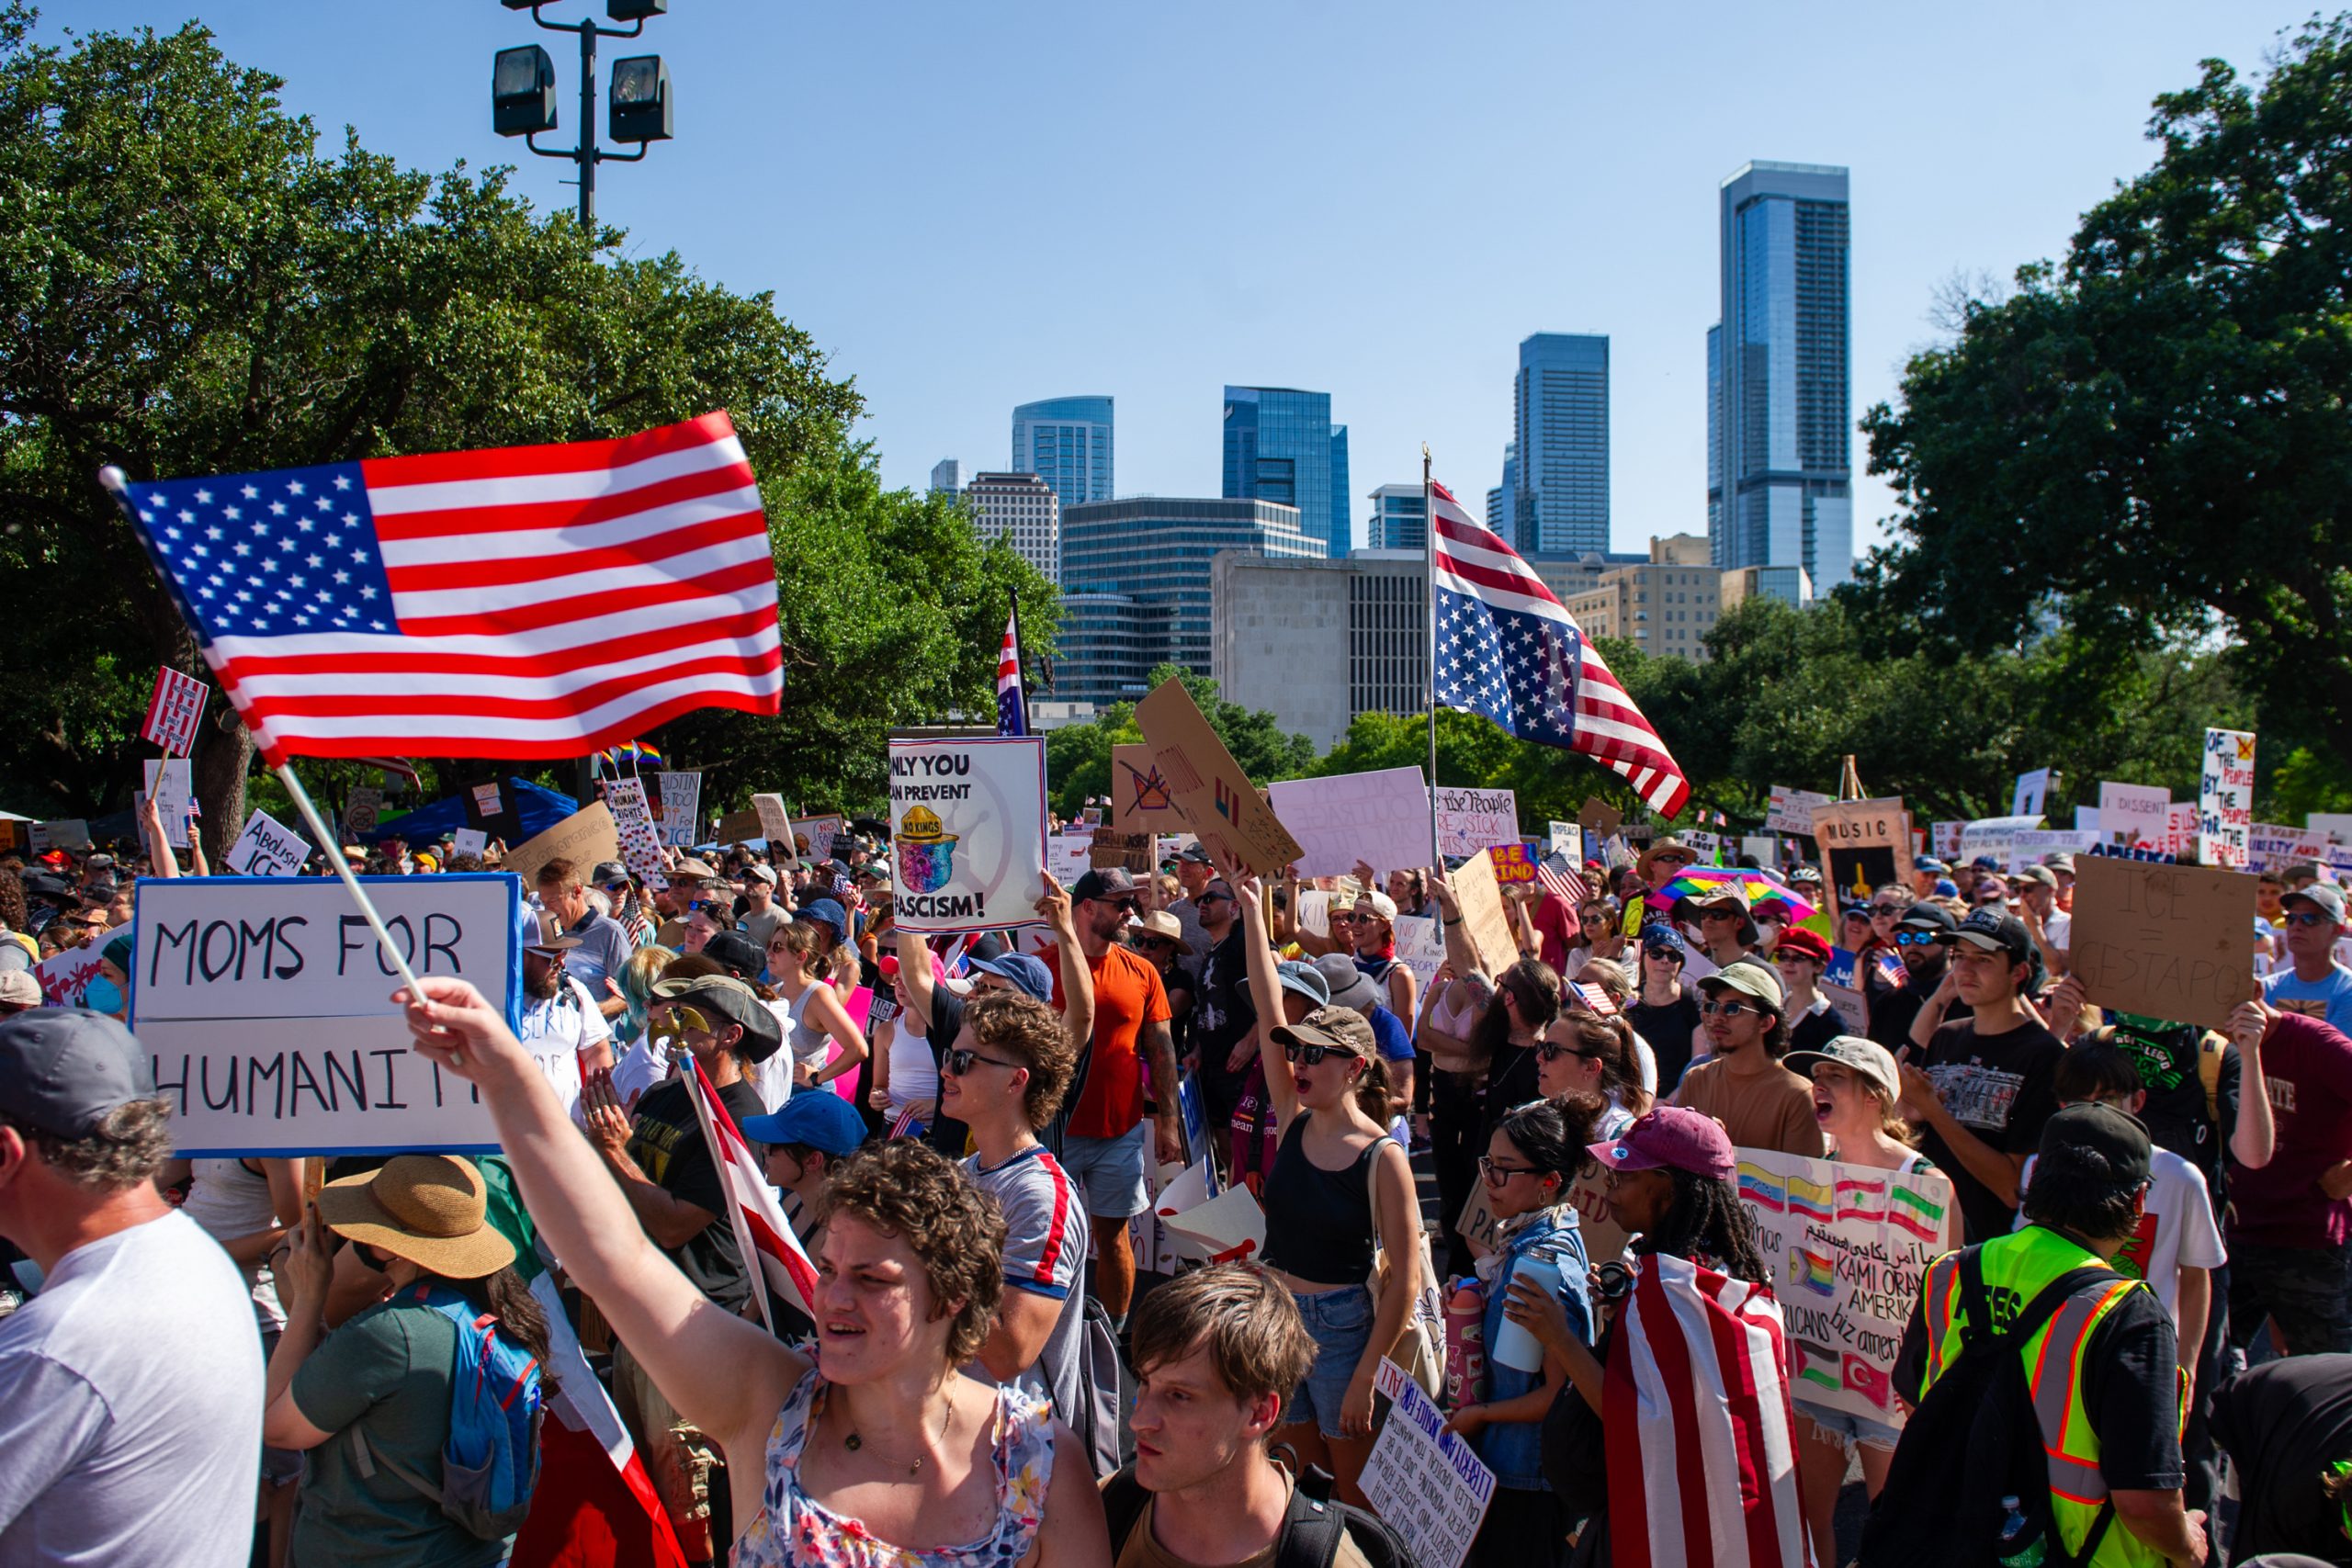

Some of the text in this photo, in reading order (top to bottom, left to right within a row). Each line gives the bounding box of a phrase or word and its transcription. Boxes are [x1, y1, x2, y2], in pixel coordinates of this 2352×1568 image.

[2207, 732, 2225, 751] OF
[890, 754, 969, 776] NLY YOU
[2217, 751, 2235, 767] THE
[661, 773, 698, 790] AUSTIN
[2203, 773, 2220, 795] BY
[2223, 768, 2253, 786] PEOPLE
[614, 794, 639, 806] HUMAN
[671, 793, 693, 806] TOO
[890, 784, 970, 800] AN PREVENT
[2218, 792, 2235, 808] THE
[1443, 790, 1511, 815] the People
[2119, 797, 2166, 815] DISSENT
[616, 807, 643, 819] RIGHTS
[2222, 809, 2250, 825] PEOPLE
[820, 824, 834, 832] NO
[903, 822, 939, 832] NO KINGS
[1436, 814, 1500, 836] RE SICK
[1827, 820, 1886, 840] MUSIC
[2200, 810, 2220, 836] FOR
[245, 820, 300, 869] ABOLISH
[668, 829, 693, 845] ICE
[1439, 837, 1463, 855] HIS
[1687, 840, 1713, 852] KINGS
[1694, 833, 1708, 841] NO
[2015, 833, 2083, 845] DEFEND THE
[2222, 829, 2243, 846] THE
[1495, 846, 1521, 863] BE
[2089, 842, 2176, 863] AMERICA
[2249, 840, 2321, 857] LIBERTY AND
[2117, 868, 2190, 920] ICE
[1399, 923, 1416, 939] NO
[150, 916, 308, 987] MOMS
[338, 913, 462, 976] FOR
[1396, 942, 1415, 956] NO
[2076, 941, 2240, 1005] GESTAPO
[1836, 1252, 1877, 1290] KAMI
[1829, 1302, 1857, 1344] biz
[1382, 1361, 1493, 1503] LIBERTY AND JUSTICE FOR ALL
[1380, 1463, 1394, 1486] FOR
[1387, 1413, 1480, 1525] CALLED RADICAL FOR WANTING
[1384, 1435, 1472, 1547] EVERY MORNING JUST TO BE
[1393, 1474, 1420, 1516] JUSTICE
[1418, 1508, 1432, 1533] AND
[1429, 1529, 1462, 1568] LIBERTY
